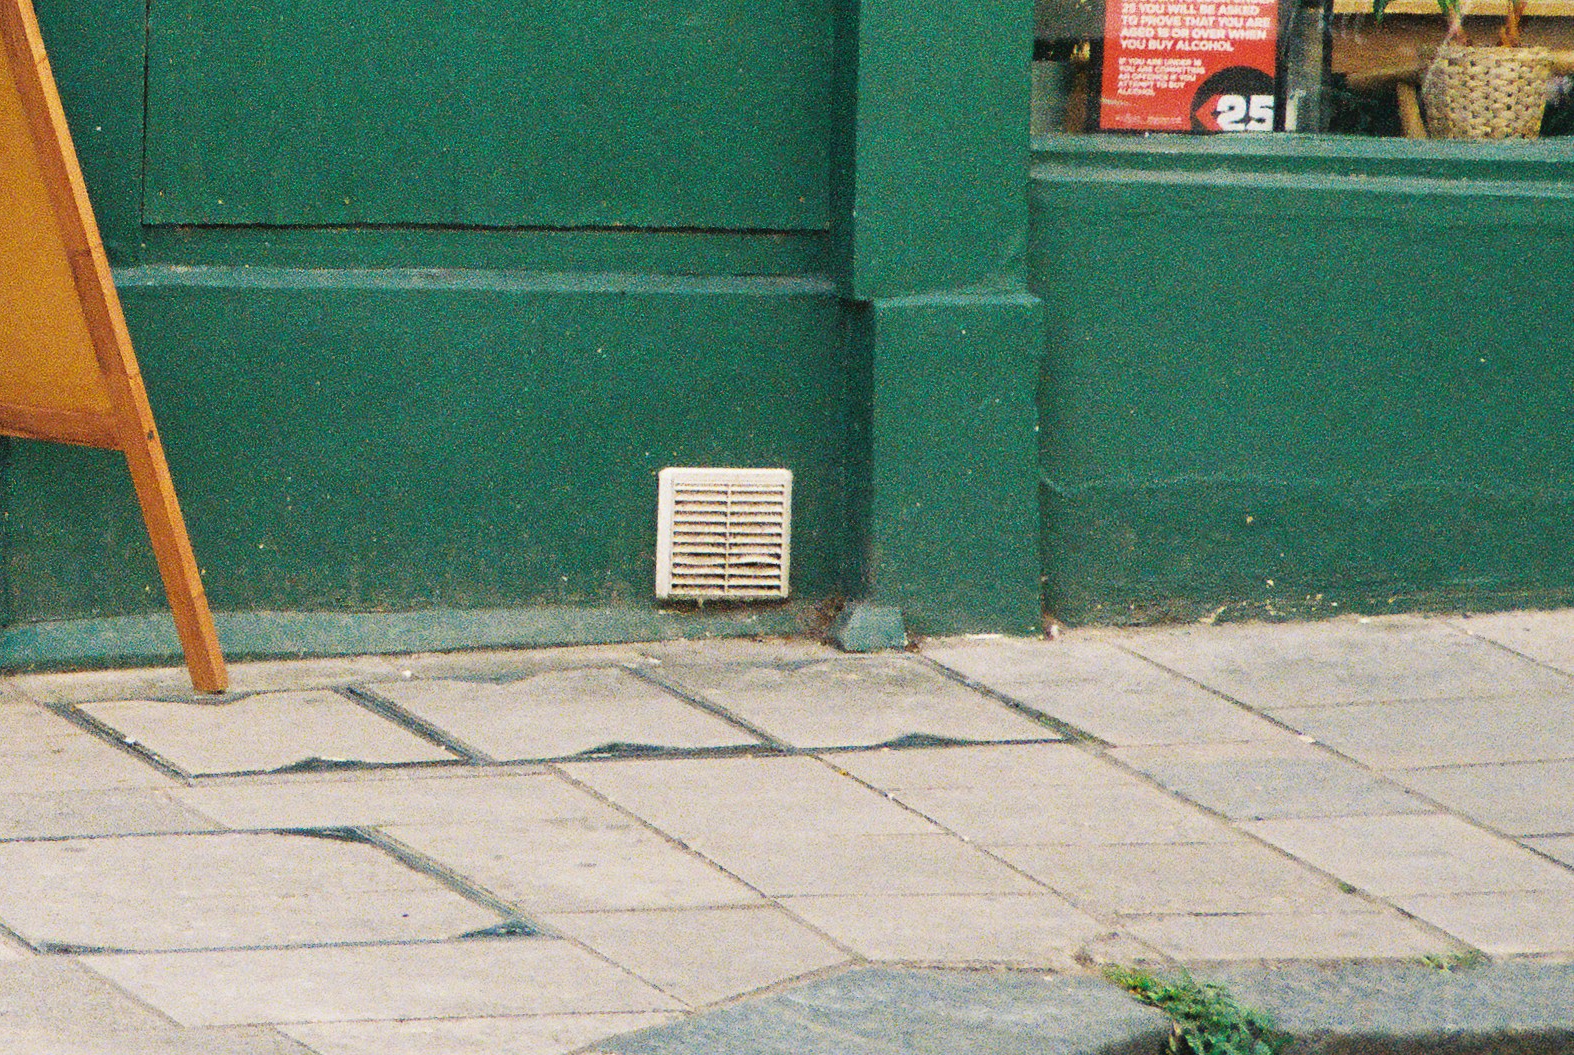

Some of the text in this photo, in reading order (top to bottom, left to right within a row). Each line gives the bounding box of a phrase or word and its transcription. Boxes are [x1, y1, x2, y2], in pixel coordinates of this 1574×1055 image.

[1122, 2, 1260, 16] 25 YOU WILL BE ASKED
[1121, 14, 1271, 29] TO PROVE THAT YOU ARE
[1120, 26, 1155, 38] AGED
[1171, 27, 1190, 39] OR
[1191, 28, 1226, 39] OVER
[1227, 29, 1268, 41] WHEN
[1120, 38, 1235, 52] YOU BUY ALCOHOL.
[1128, 57, 1145, 66] YOU
[1146, 58, 1163, 66] ARE
[1163, 58, 1192, 66] UNDER
[1118, 65, 1136, 74] YOU
[1137, 66, 1153, 74] ARE
[1178, 74, 1197, 82] YOU
[1156, 81, 1168, 90] TO
[1168, 81, 1186, 90] BUY
[1216, 94, 1275, 131] 25
